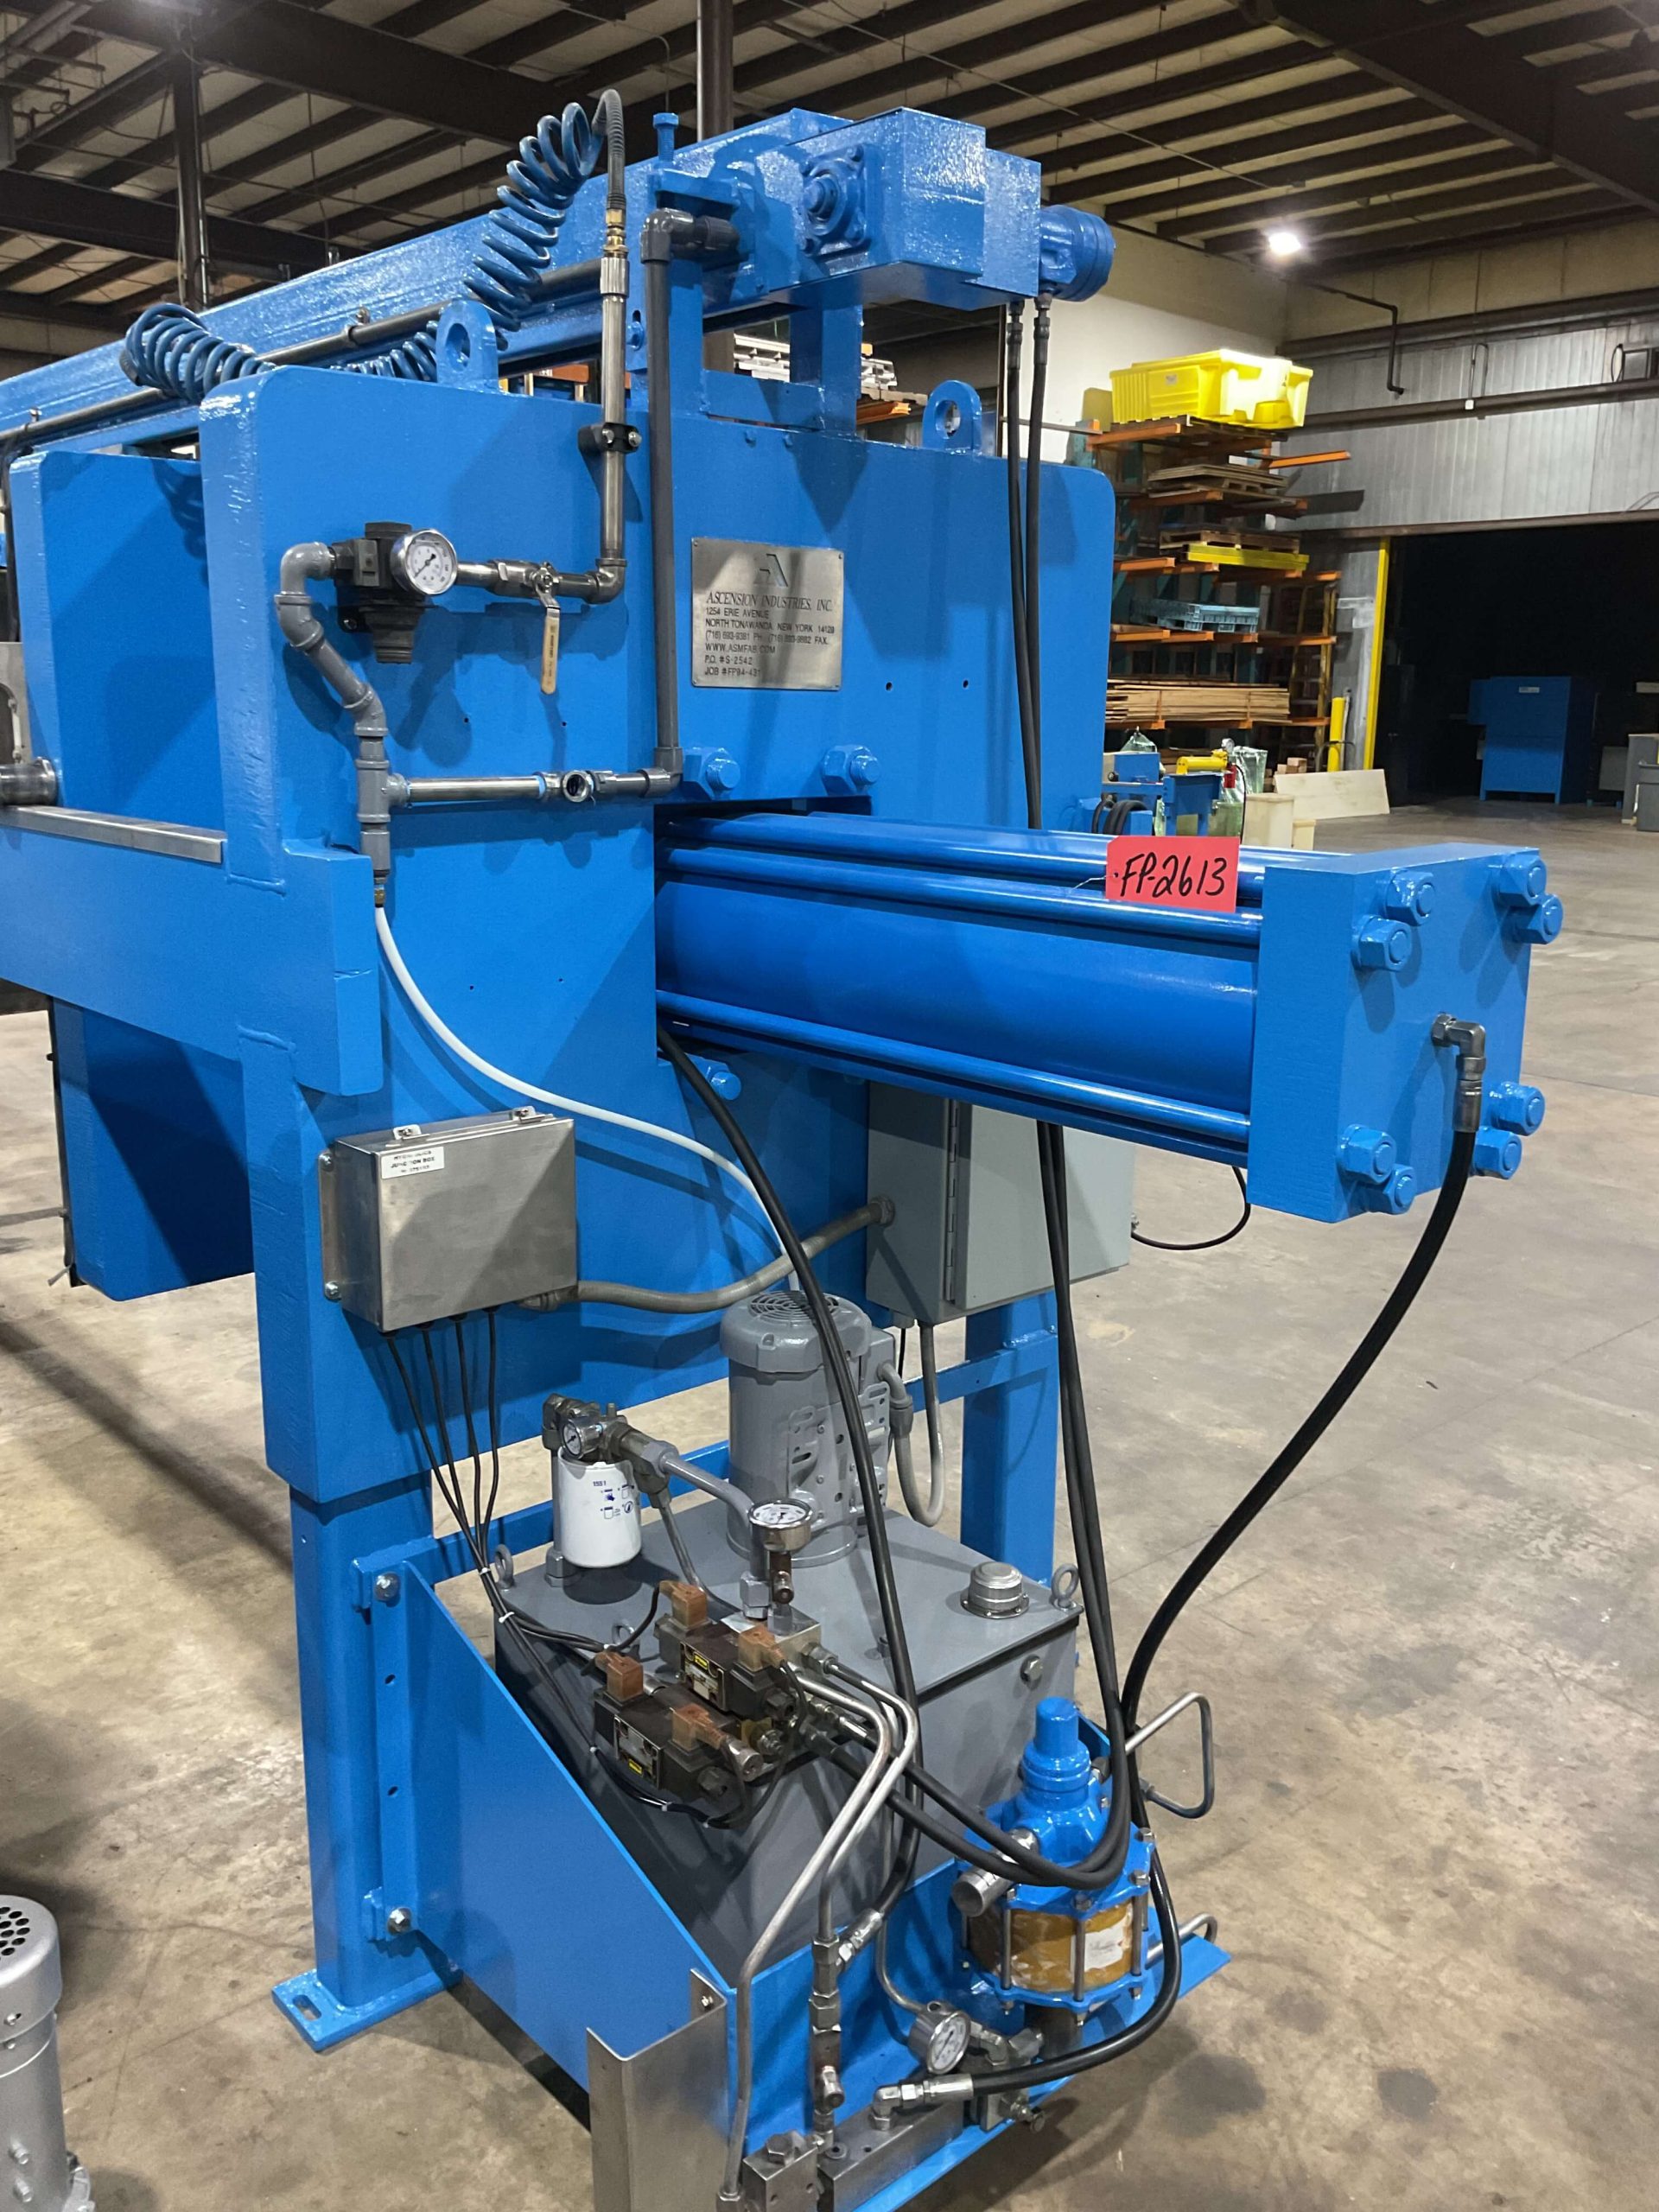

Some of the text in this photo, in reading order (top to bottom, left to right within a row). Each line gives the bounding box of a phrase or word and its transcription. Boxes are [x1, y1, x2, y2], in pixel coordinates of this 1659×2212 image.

[706, 591, 758, 606] ASCENSION
[706, 607, 769, 620] 1254 ERIE AVENUE
[705, 618, 729, 629] NORTH
[778, 622, 792, 632] NEW
[795, 623, 813, 632] YORK
[705, 666, 719, 676] JOB
[1120, 851, 1227, 899] FP-2613
